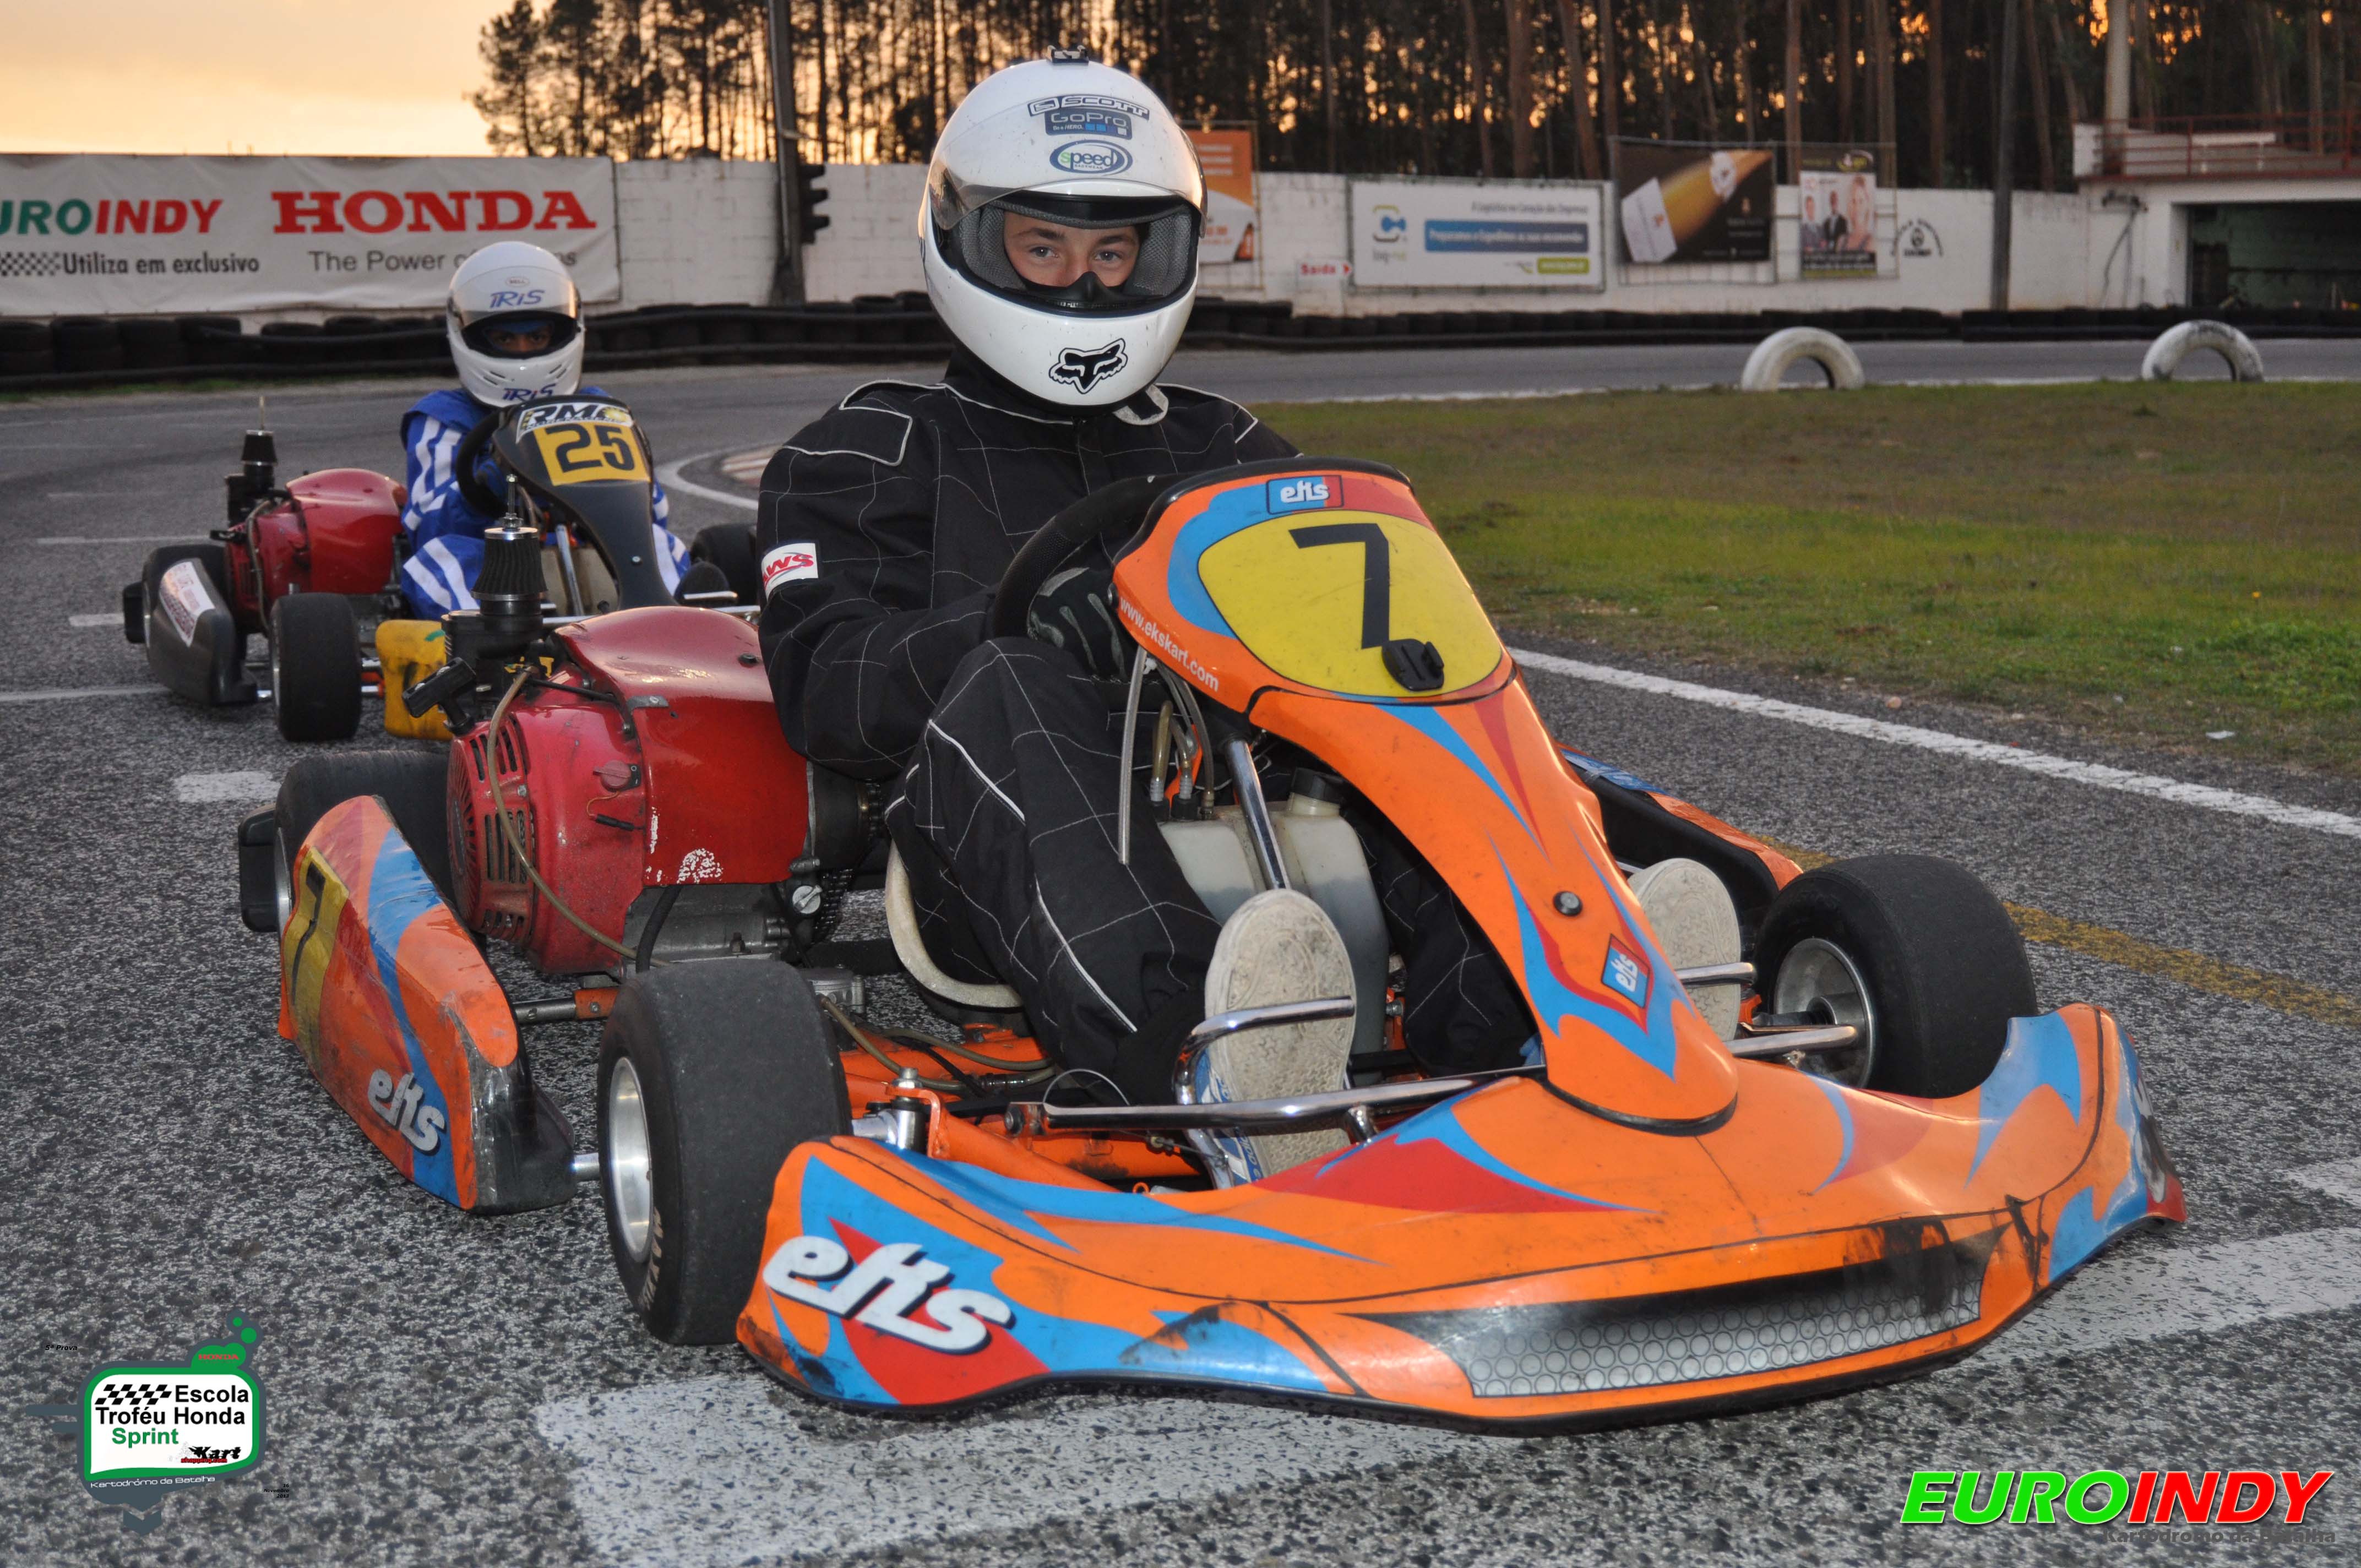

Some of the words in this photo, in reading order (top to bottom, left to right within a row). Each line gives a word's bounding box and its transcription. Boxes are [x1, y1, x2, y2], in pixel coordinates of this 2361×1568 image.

[1061, 96, 1149, 117] SCOTT
[1051, 112, 1127, 127] GoPro
[1059, 149, 1114, 170] speed
[271, 190, 597, 235] HONDA
[62, 252, 129, 274] Utiliza
[136, 258, 166, 274] em
[172, 252, 259, 273] exclusivo
[307, 251, 357, 271] The
[367, 251, 444, 271] Power
[543, 423, 635, 473] 25
[1288, 522, 1390, 650] 7
[1119, 597, 1219, 692] www.ekskart.com
